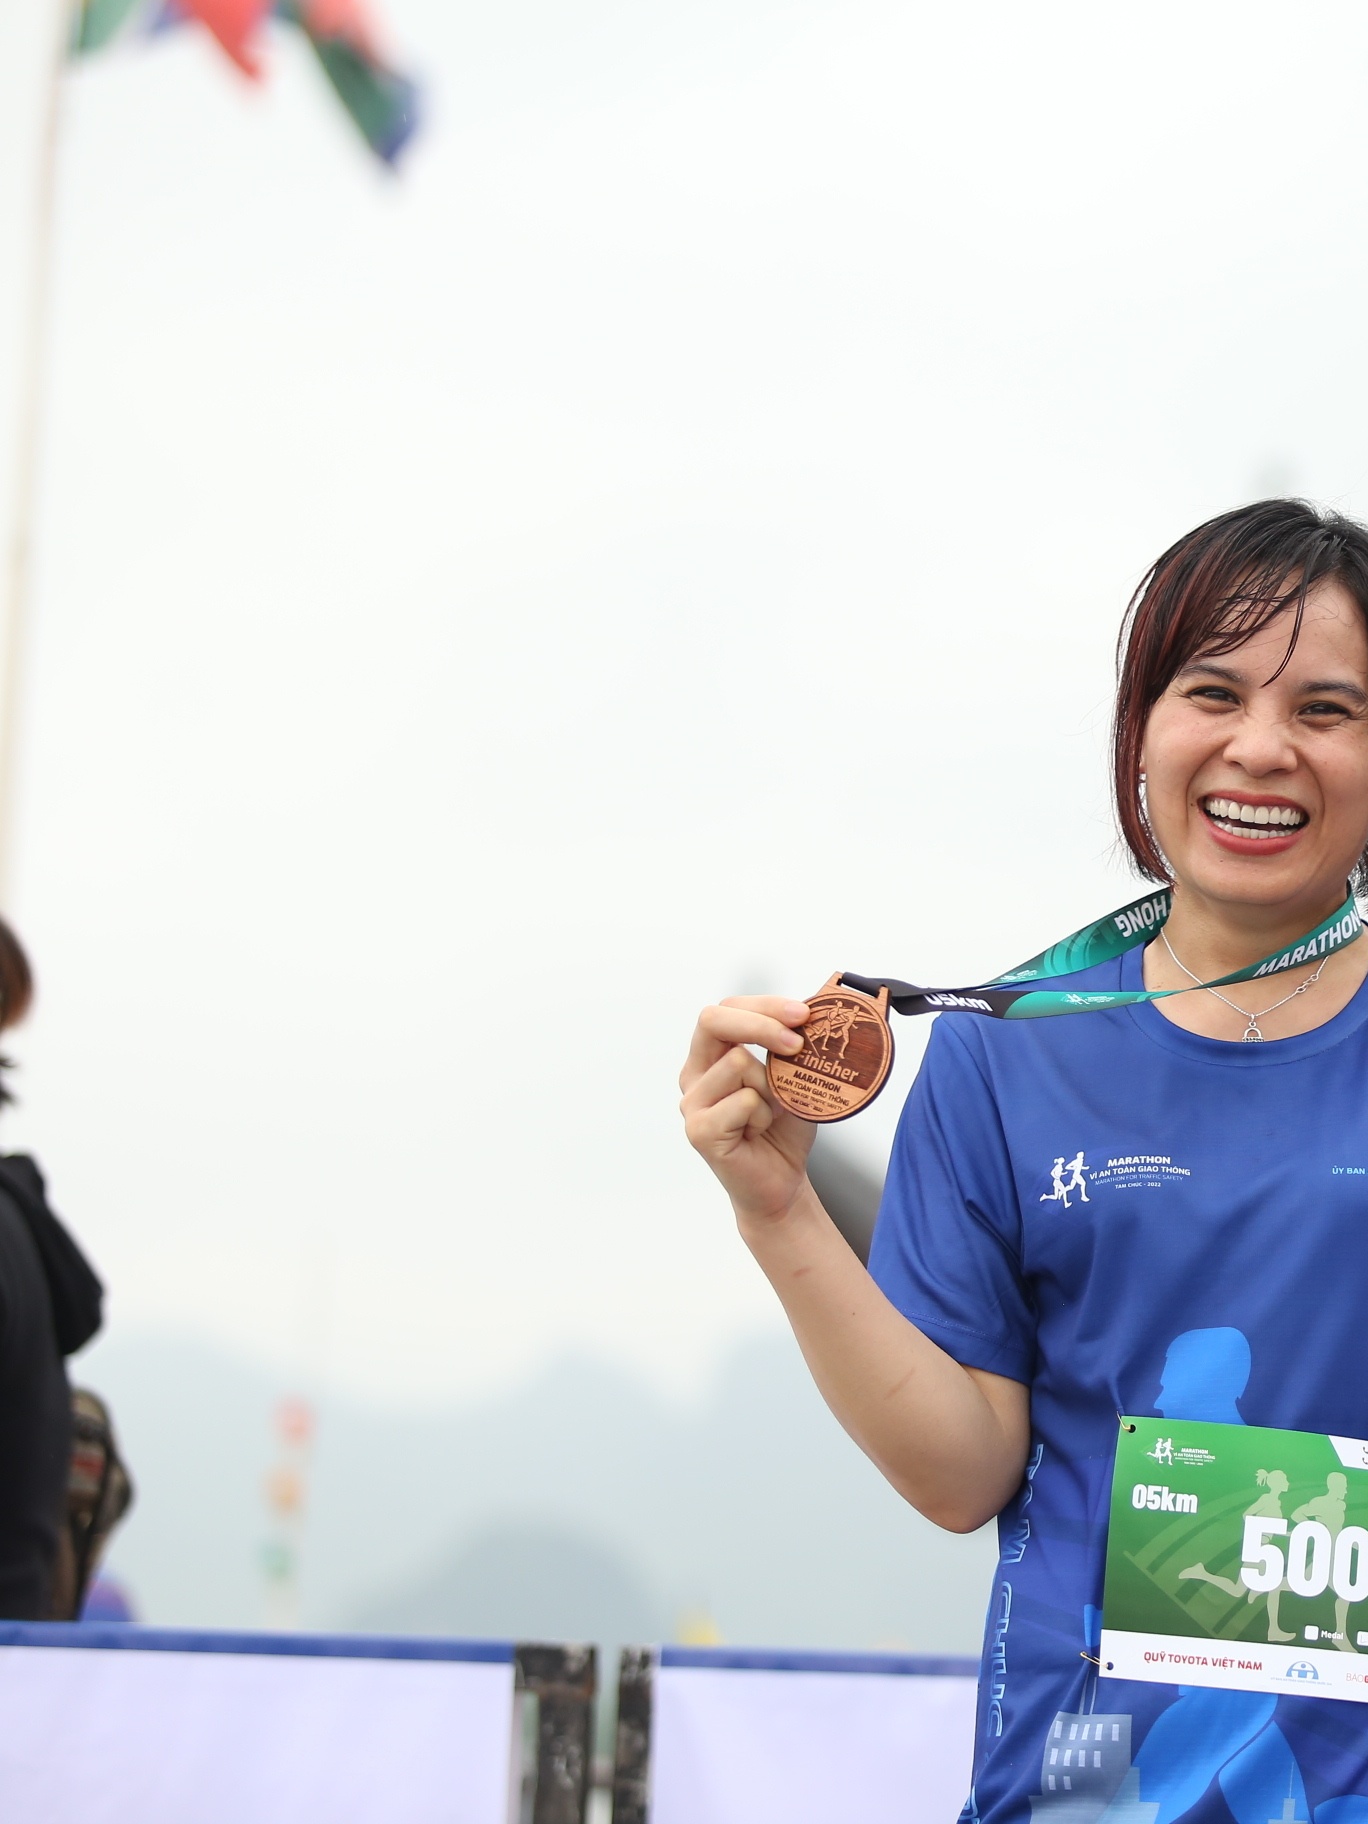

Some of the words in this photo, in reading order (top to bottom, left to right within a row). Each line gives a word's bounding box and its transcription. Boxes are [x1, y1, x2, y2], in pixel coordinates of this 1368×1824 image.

[1114, 894, 1170, 938] HÔNG
[1253, 905, 1361, 978] MARATHON
[794, 1049, 859, 1082] Finisher
[784, 1078, 793, 1086] AN
[794, 1081, 812, 1093] TOÀN
[812, 1088, 827, 1098] GIAO
[793, 1070, 842, 1093] MARATHON
[1107, 1156, 1171, 1167] MARATHON
[1332, 1165, 1344, 1174] ỦY
[1347, 1167, 1365, 1175] BAN
[1089, 1171, 1098, 1180] VÌ
[1099, 1169, 1111, 1178] AN
[1112, 1166, 1136, 1175] TOÀN
[1095, 1176, 1126, 1186] MARATHON
[1132, 1484, 1198, 1513] 05km
[1321, 1630, 1344, 1640] Medal
[1144, 1651, 1166, 1663] QUỸ
[1168, 1654, 1208, 1666] TOYOTA
[1211, 1657, 1235, 1670] VIỆT
[1237, 1660, 1262, 1670] NAM
